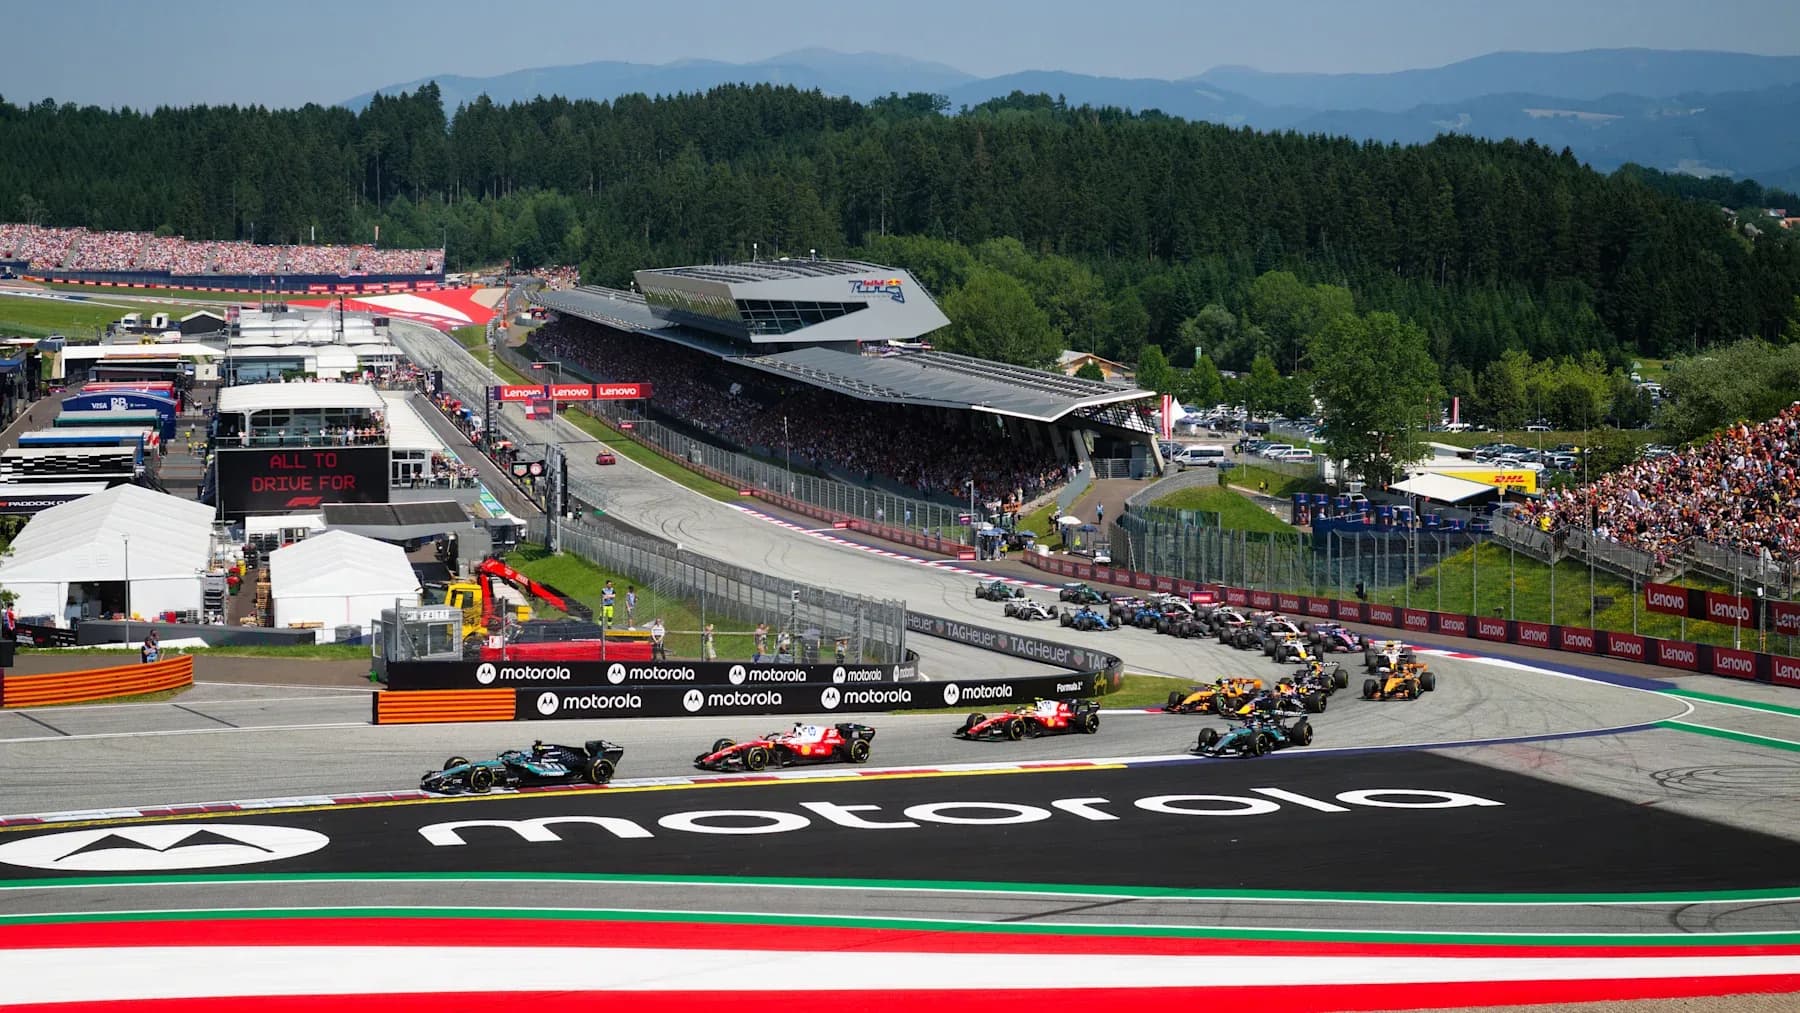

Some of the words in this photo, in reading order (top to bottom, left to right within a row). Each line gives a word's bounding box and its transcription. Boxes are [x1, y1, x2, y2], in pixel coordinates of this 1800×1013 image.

[504, 389, 541, 397] Lenovo
[552, 388, 589, 396] Lenovo
[600, 387, 637, 395] Lenovo
[270, 453, 306, 469] ALL
[313, 452, 337, 468] TO
[252, 476, 313, 492] DRIVE
[319, 475, 355, 491] FOR
[1280, 597, 1299, 610] Lenovo
[1648, 588, 1685, 609] Lenovo
[1309, 600, 1329, 613] Lenovo
[1339, 604, 1359, 616] Lenovo
[1710, 598, 1749, 621] Lenovo
[1371, 608, 1392, 621] Lenovo
[1404, 612, 1427, 627] Lenovo
[1441, 617, 1465, 631] Lenovo
[1479, 622, 1504, 636] Lenovo
[1520, 627, 1547, 642] Lenovo
[1563, 630, 1593, 649] Lenovo
[1610, 638, 1642, 655] Lenovo
[1661, 644, 1694, 663] Lenovo
[1717, 653, 1752, 673] Lenovo
[500, 666, 571, 680] motorola
[629, 666, 695, 680] motorola
[749, 668, 806, 682] motorola
[848, 668, 882, 682] motorola
[708, 690, 782, 706] motorola
[844, 688, 912, 704] motorola
[962, 684, 1013, 700] motorola
[563, 693, 642, 709] motorola
[418, 787, 1505, 846] motorola
